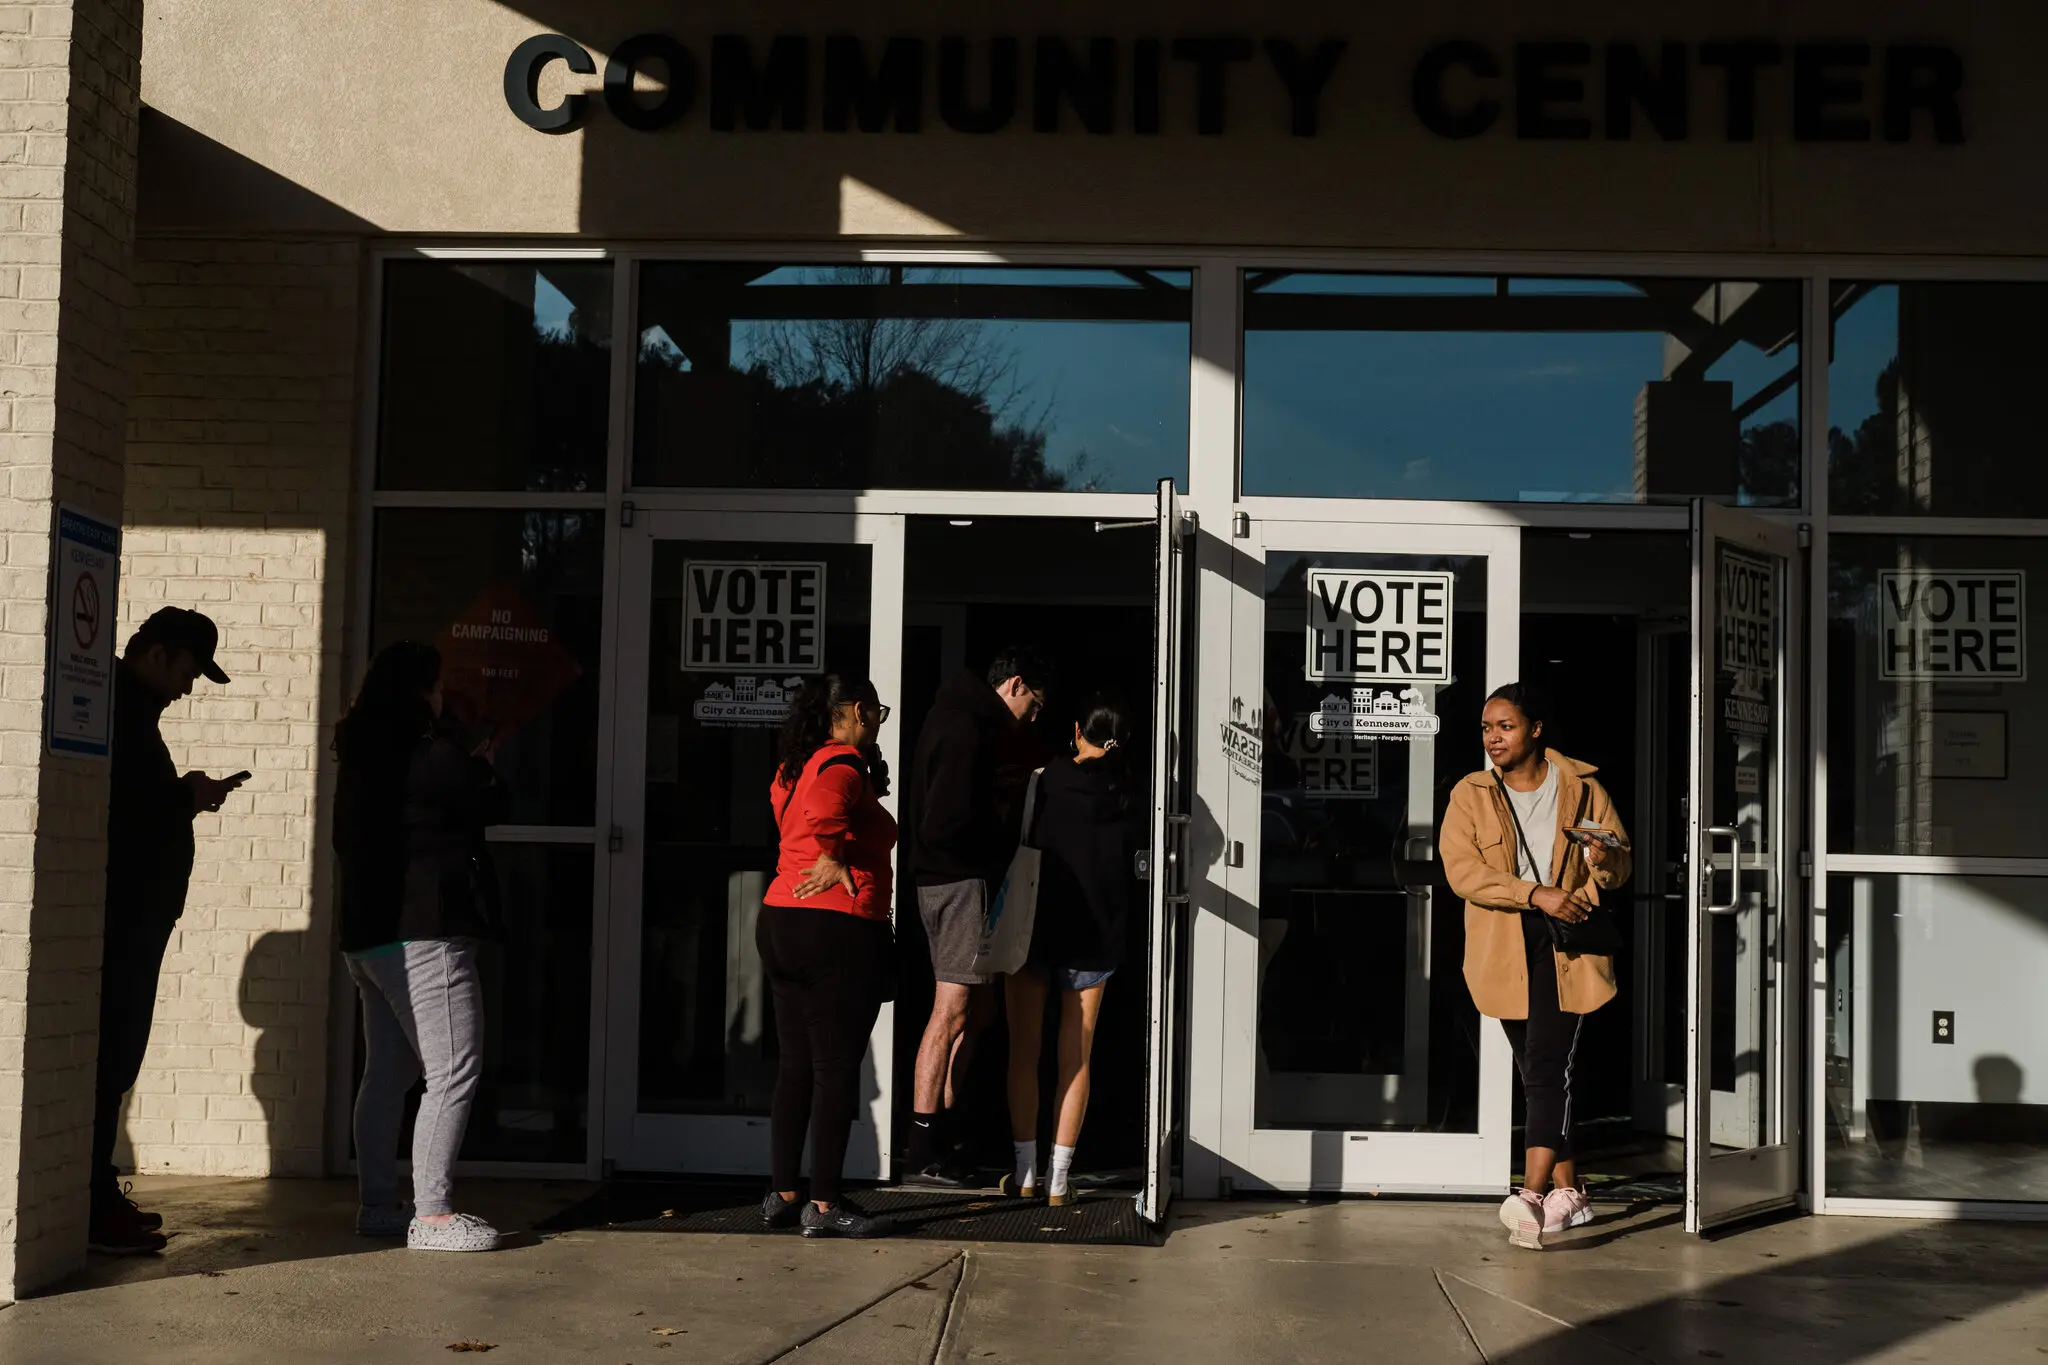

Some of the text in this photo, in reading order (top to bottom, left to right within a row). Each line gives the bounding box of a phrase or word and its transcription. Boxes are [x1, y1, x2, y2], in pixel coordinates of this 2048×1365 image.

[504, 34, 1966, 142] COMMUNITY CENTER
[693, 569, 815, 615] VOTE
[1317, 580, 1443, 625] VOTE
[1725, 563, 1769, 617] VOTE
[1887, 580, 2017, 622] VOTE
[452, 622, 548, 643] CAMPAIGNING
[491, 609, 512, 624] NO
[692, 618, 813, 663] HERE
[1316, 629, 1442, 674] HERE
[1725, 615, 1769, 667] HERE
[1887, 629, 2017, 671] HERE
[481, 667, 520, 679] 150 FEET
[702, 706, 722, 716] City
[727, 707, 737, 715] of
[1318, 718, 1340, 729] City
[1343, 718, 1353, 727] of
[1415, 720, 1432, 729] GA
[1724, 698, 1769, 724] KENNESAW
[1300, 758, 1371, 790] ERE
